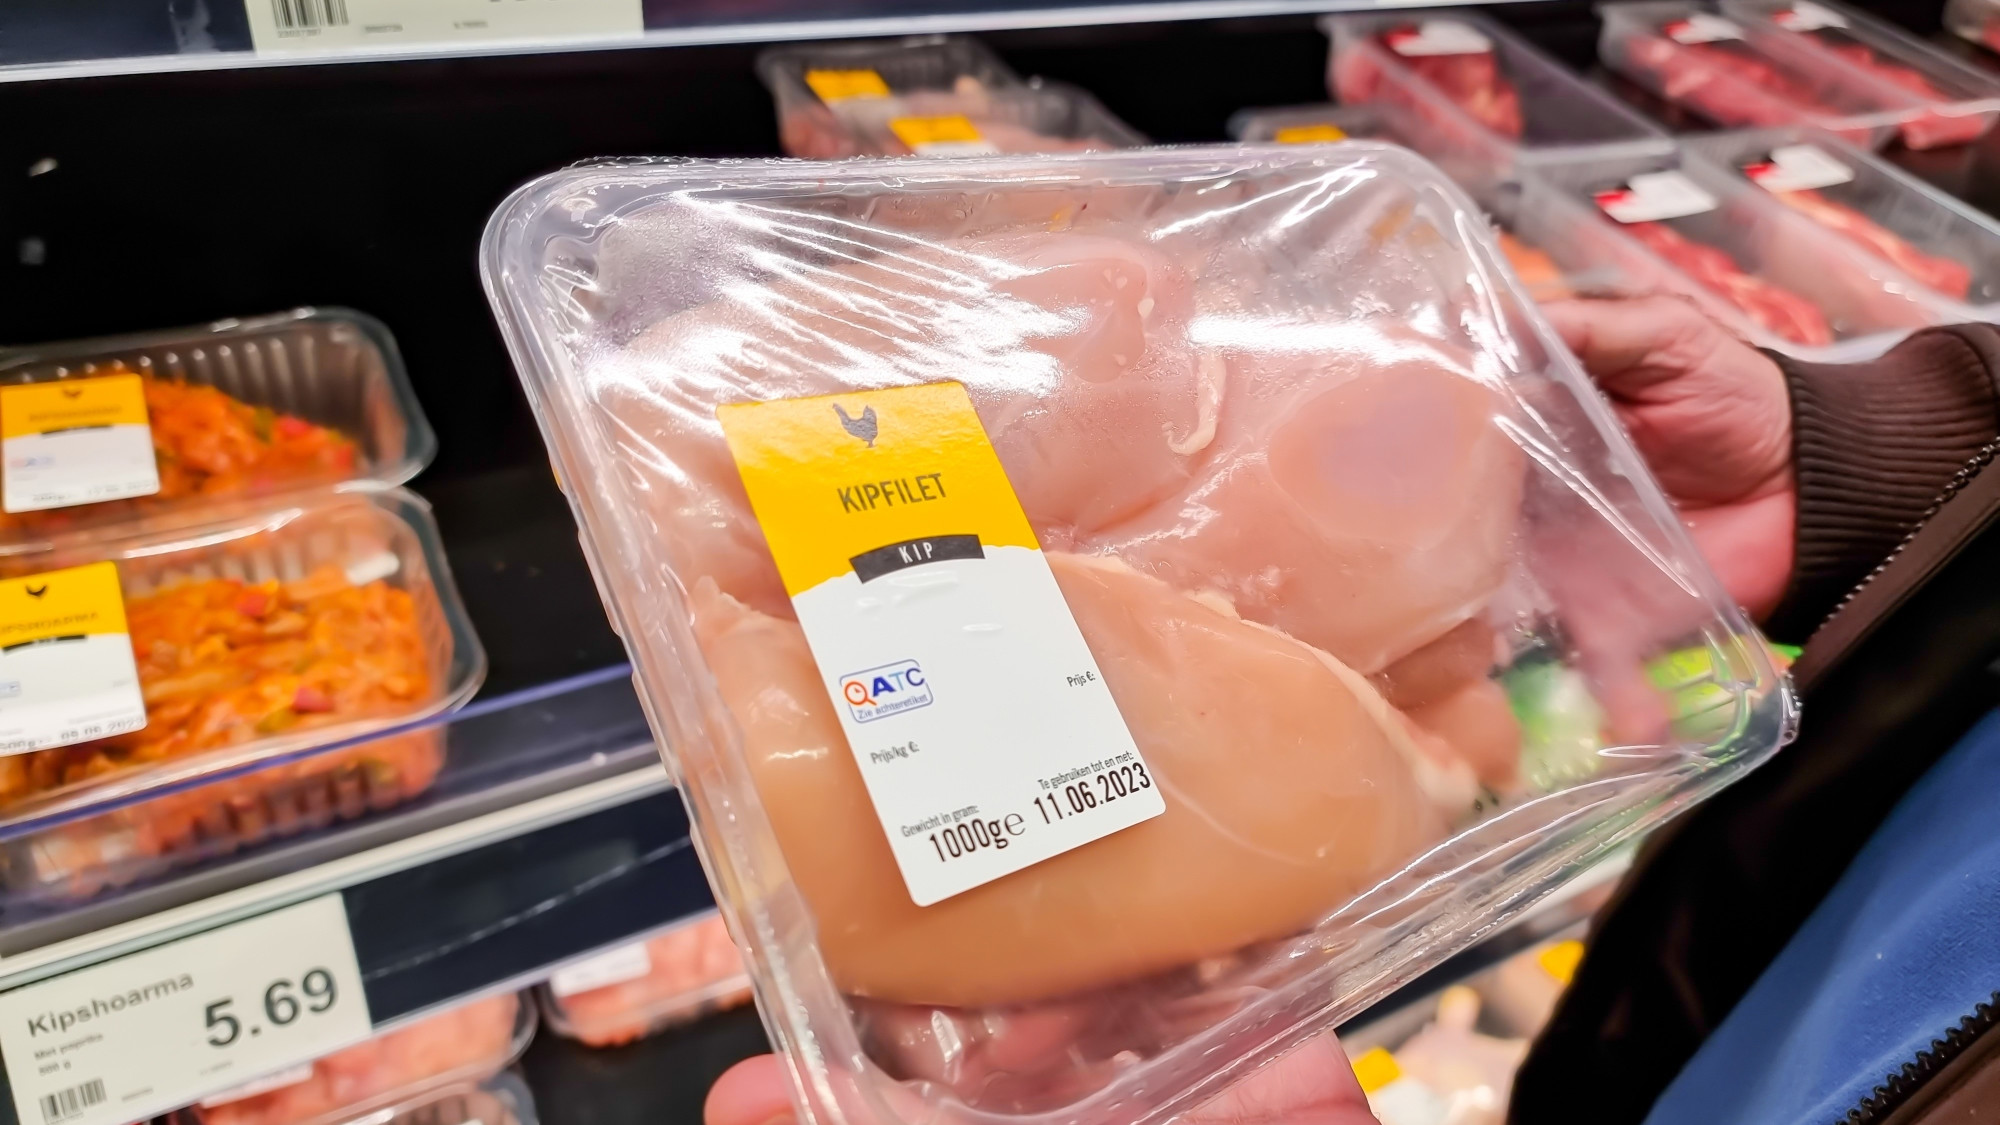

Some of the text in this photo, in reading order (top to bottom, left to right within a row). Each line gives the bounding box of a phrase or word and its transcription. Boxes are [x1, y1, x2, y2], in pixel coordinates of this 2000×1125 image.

[837, 473, 946, 514] KIPFILET
[899, 541, 933, 564] KIP
[1066, 674, 1087, 687] Prijs
[857, 694, 929, 720] Zie achteretiket
[870, 745, 909, 764] Prijs/kg
[1038, 751, 1135, 790] Te gebruiken tot en met:
[1034, 762, 1151, 825] 11.06.2023
[901, 815, 942, 838] Gewicht
[940, 812, 952, 824] in
[27, 972, 195, 1037] Kipshoarma
[204, 967, 339, 1048] 5.69
